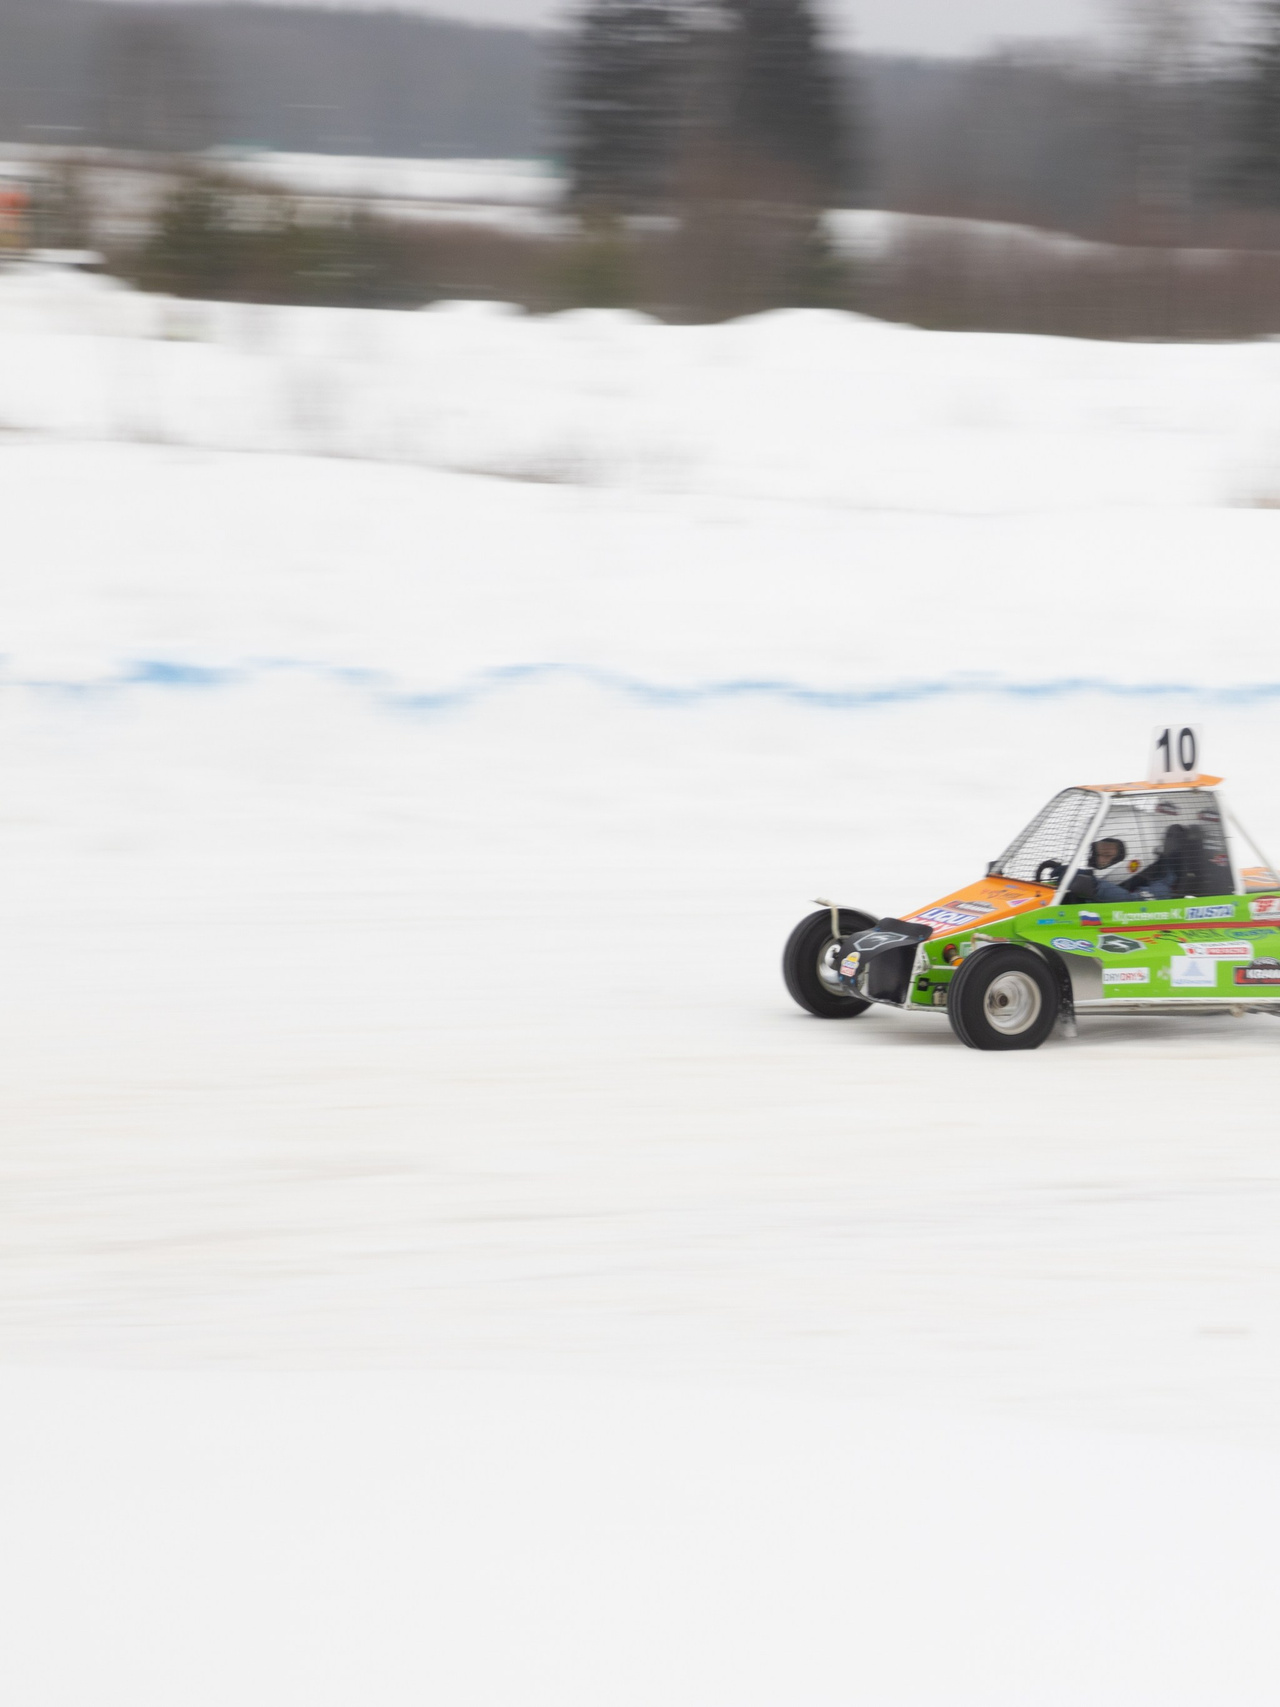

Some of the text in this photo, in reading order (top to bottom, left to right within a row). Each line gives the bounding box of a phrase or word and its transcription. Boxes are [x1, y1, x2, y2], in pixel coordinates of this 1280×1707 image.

[1156, 727, 1196, 772] 10
[918, 908, 979, 926] LIQUI
[1186, 906, 1234, 919] RUSTA
